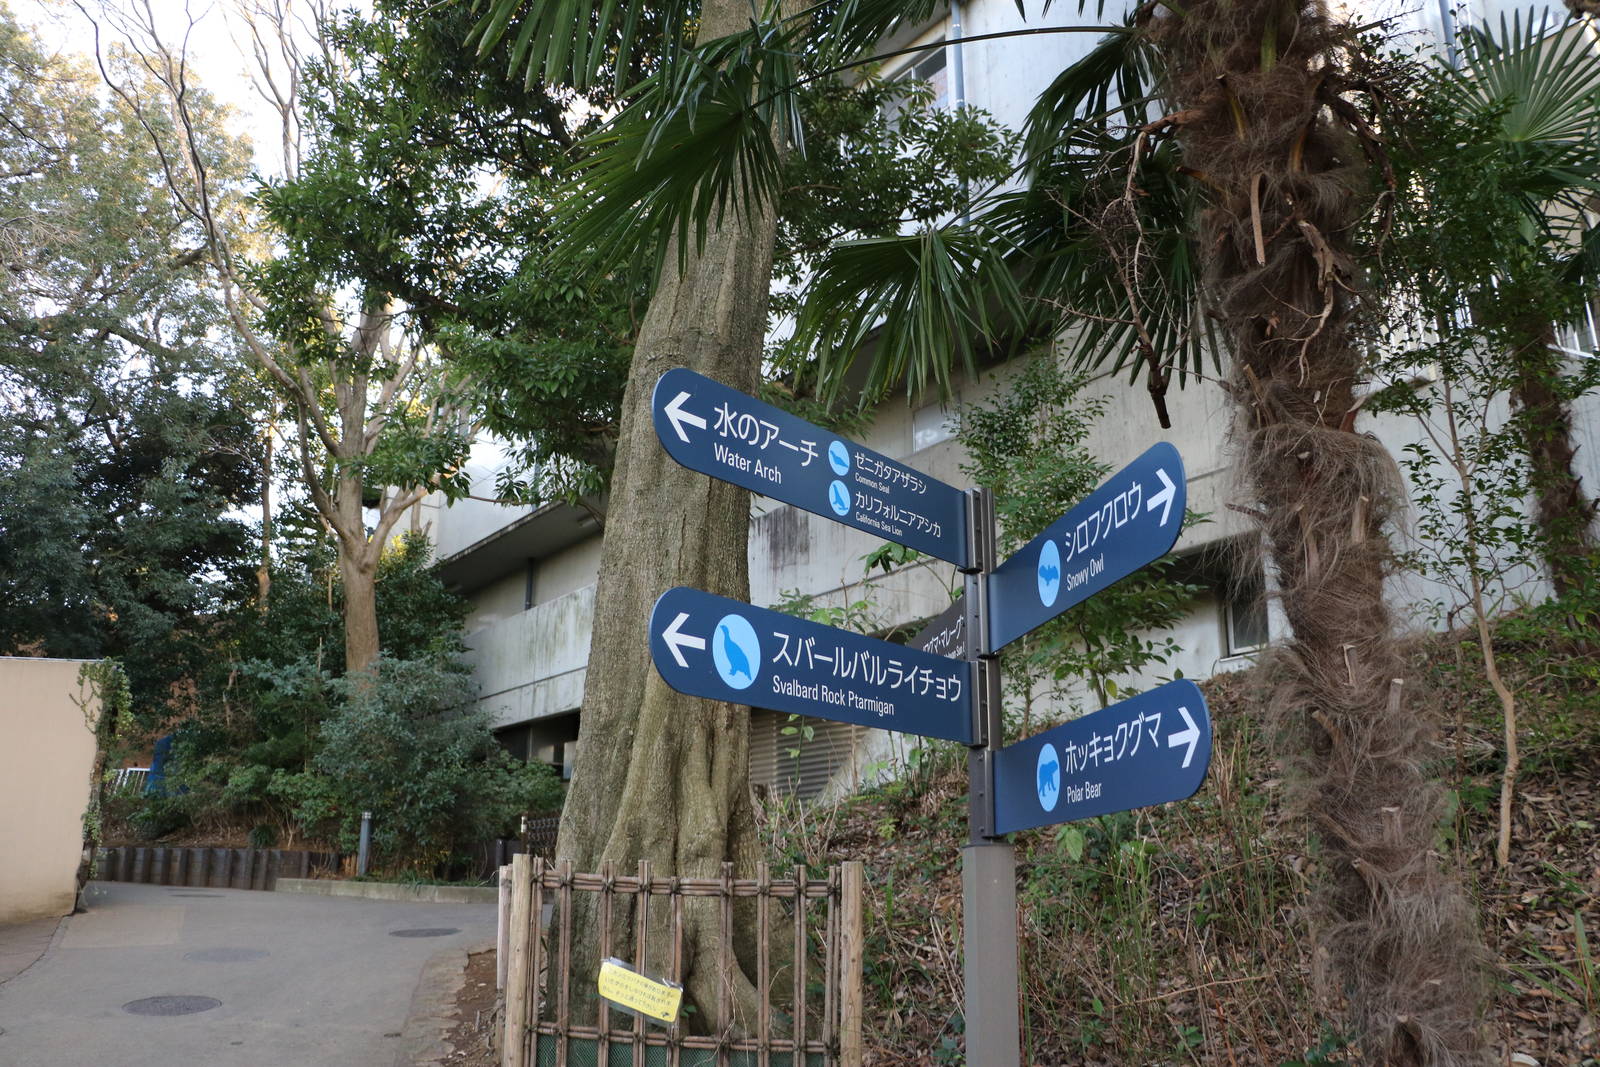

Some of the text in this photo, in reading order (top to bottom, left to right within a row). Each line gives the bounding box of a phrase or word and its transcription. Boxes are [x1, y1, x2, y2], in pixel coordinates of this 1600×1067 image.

[713, 401, 819, 467] 水のアーチ
[713, 442, 782, 485] Water Arch
[854, 451, 927, 494] ゼニガタアザラシ
[854, 472, 890, 494] Common Seal
[855, 491, 941, 538] カリフォルニアアシカ
[855, 511, 903, 537] California Sea Lion
[1065, 481, 1142, 562] シロフクロウ
[1066, 553, 1105, 592] Snowy Owl
[772, 631, 961, 703] スバールバルライチョウ
[772, 674, 895, 717] Svalbard Rock Ptarmigan
[1065, 711, 1162, 775] ホッキョクグマ
[1066, 781, 1102, 804] Polar Bear
